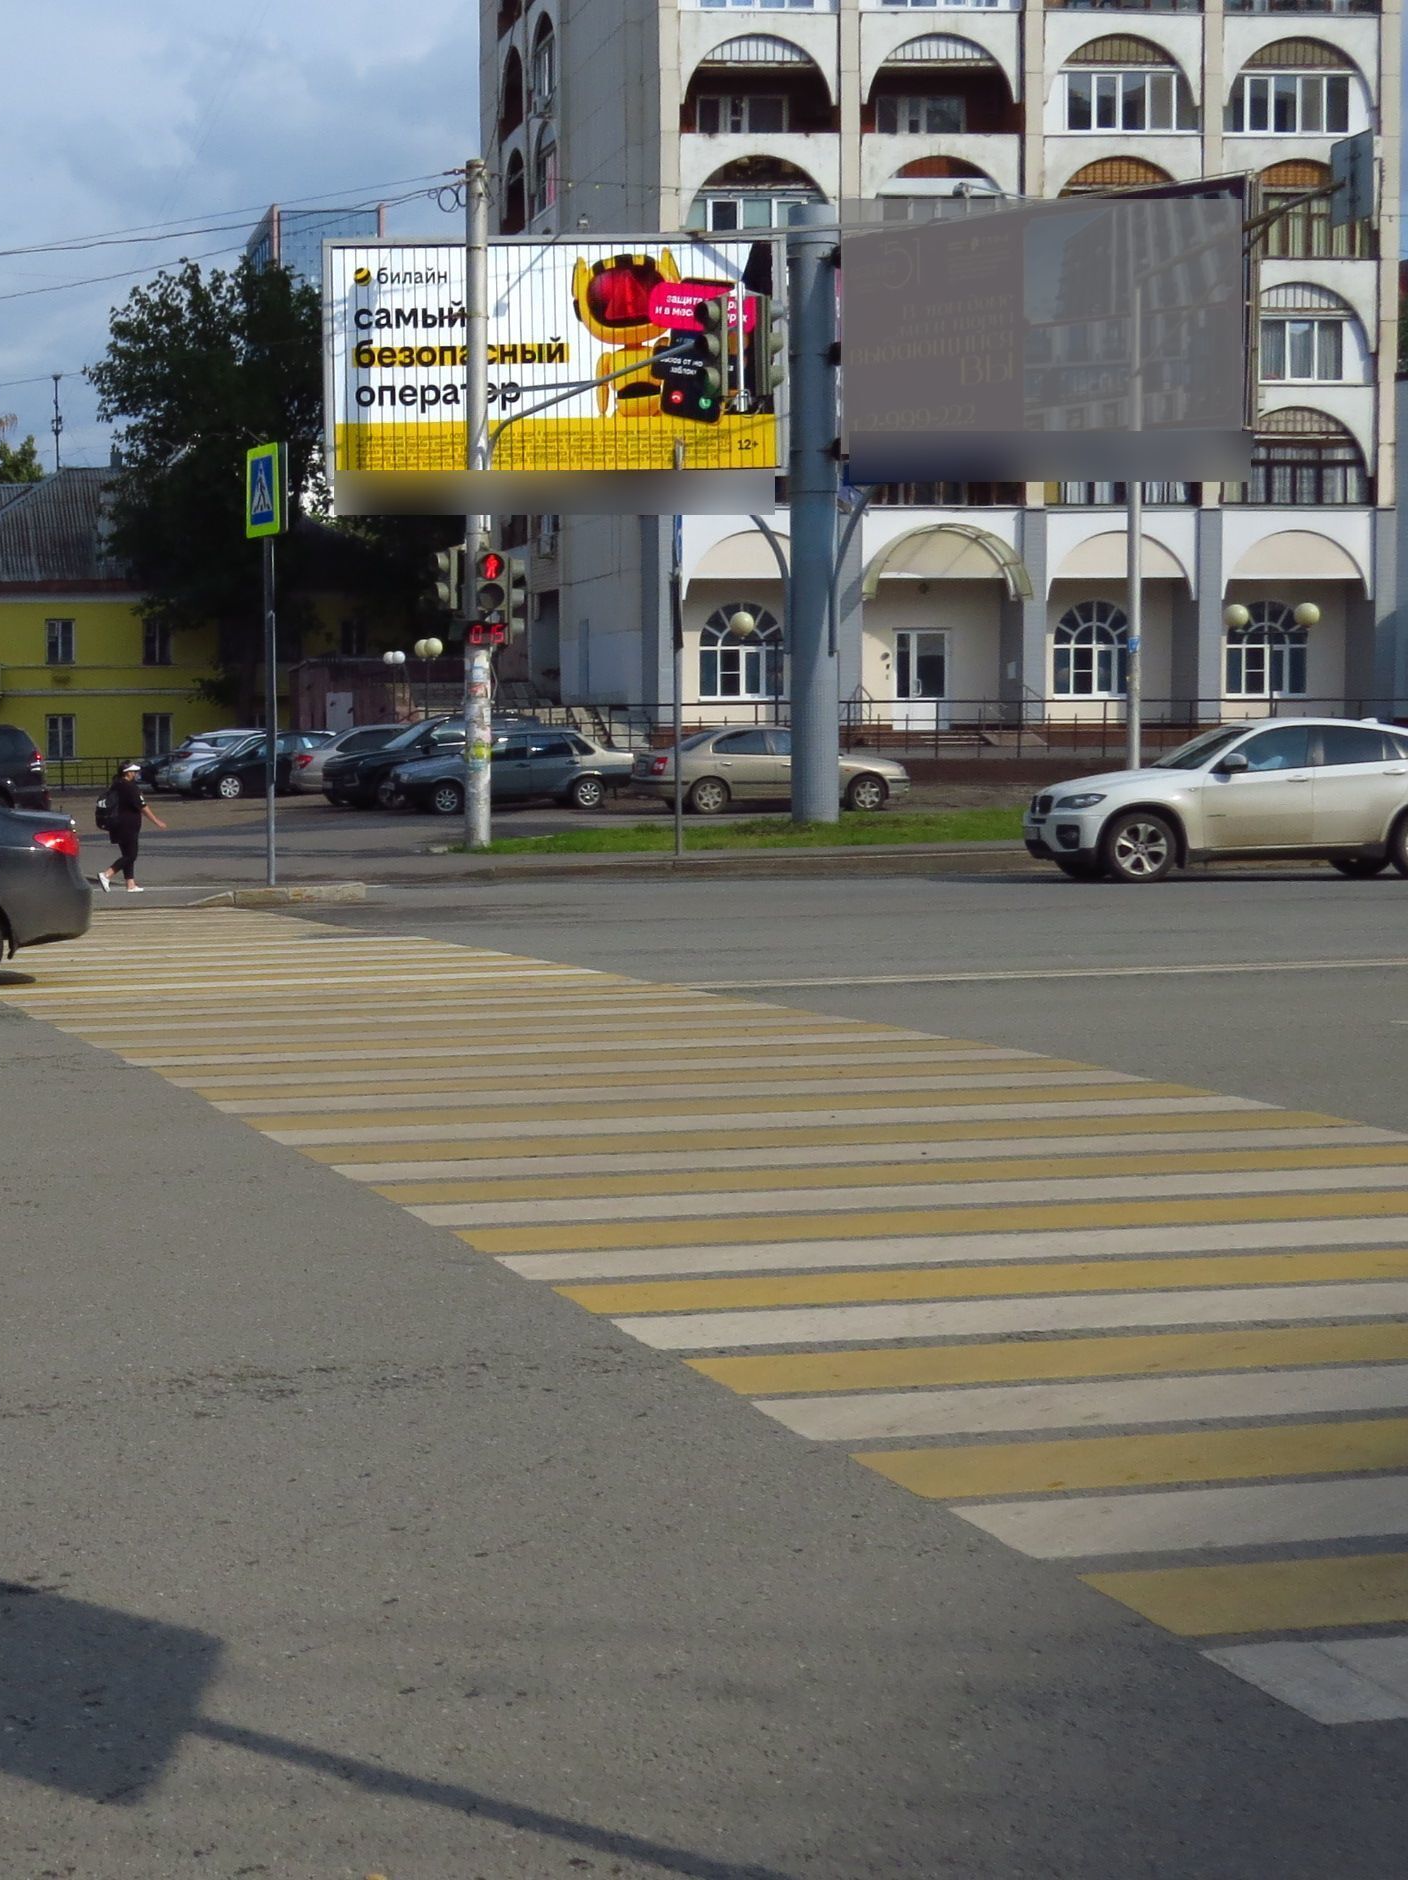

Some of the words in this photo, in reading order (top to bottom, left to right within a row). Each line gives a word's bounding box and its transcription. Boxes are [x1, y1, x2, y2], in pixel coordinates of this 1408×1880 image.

[376, 267, 448, 284] билайн
[354, 300, 466, 331] самый
[355, 381, 521, 413] операр
[737, 438, 759, 451] 12+
